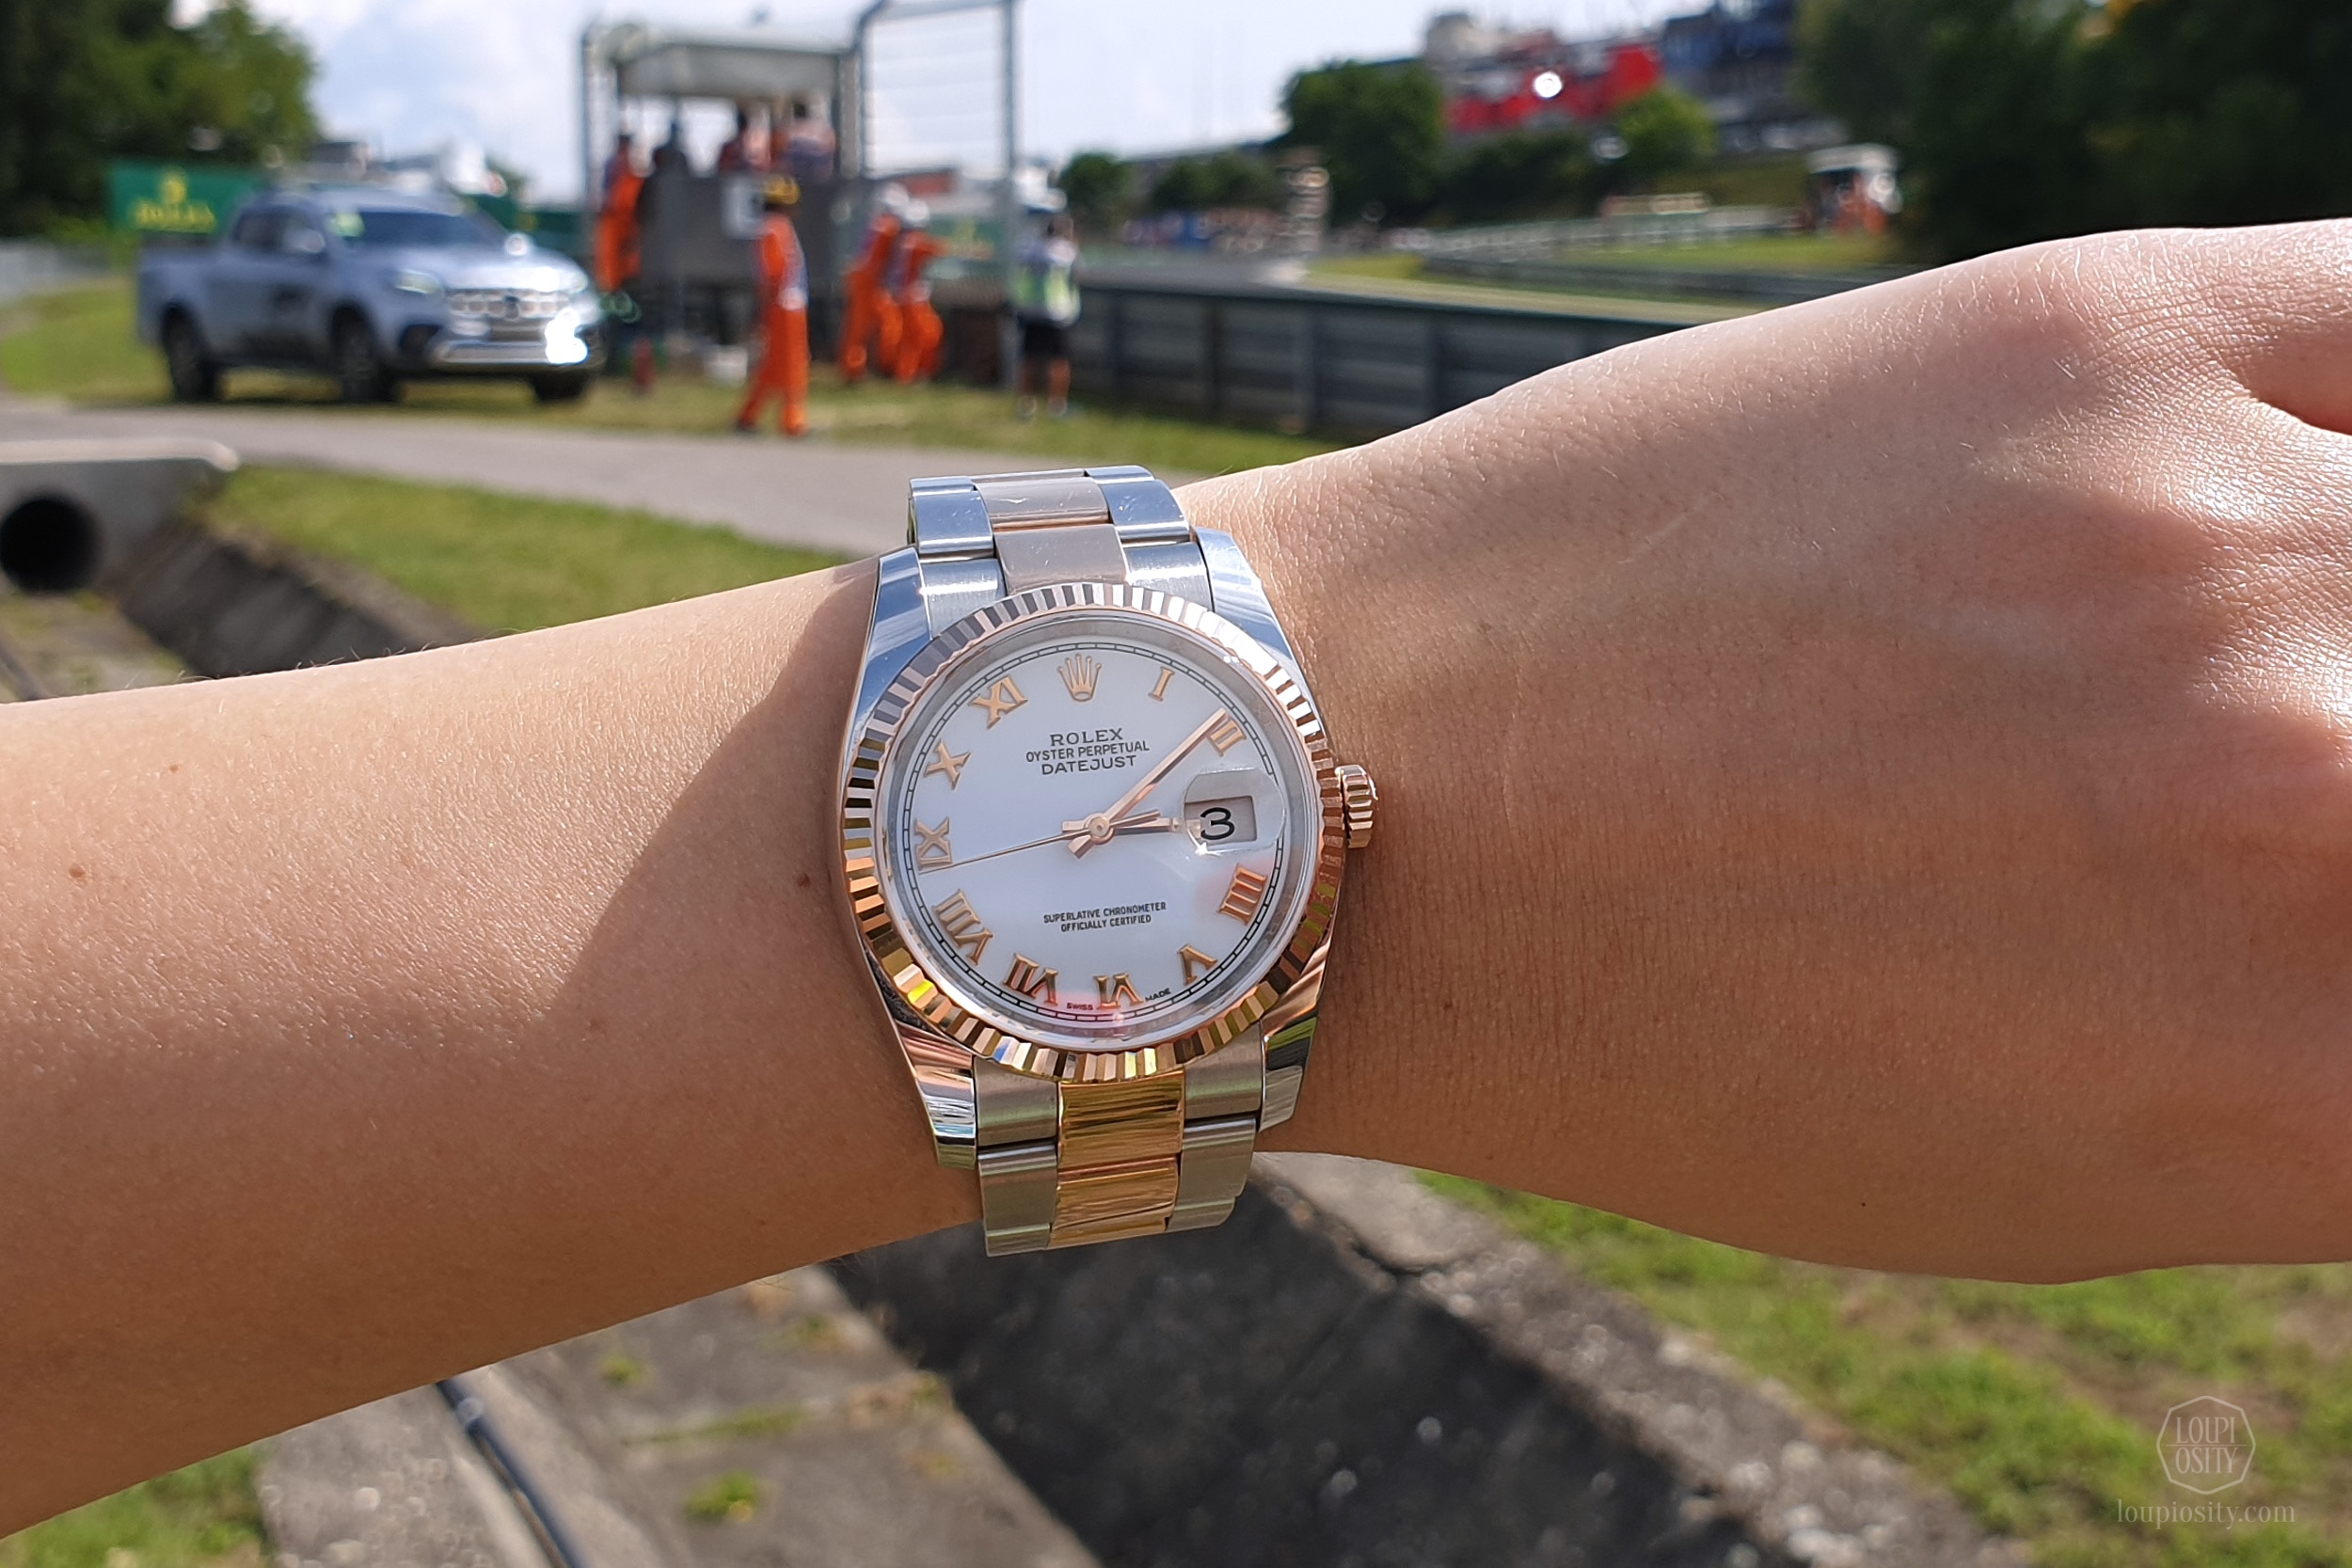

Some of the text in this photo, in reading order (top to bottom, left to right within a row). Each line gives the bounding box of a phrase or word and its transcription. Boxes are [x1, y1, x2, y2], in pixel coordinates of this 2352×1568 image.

[1148, 666, 1175, 702] I
[968, 674, 1028, 730] XI
[1025, 740, 1150, 763] OYSTER PERPETUAL
[1049, 728, 1123, 747] ROLEX
[923, 738, 971, 790] X
[1041, 754, 1136, 775] DATEJUST
[1200, 806, 1235, 841] 3
[914, 816, 953, 871] IX
[1043, 901, 1167, 924] SUPERLATIVE CHRONOMETER
[1060, 914, 1152, 932] OFFICIALLY CERTIFIED
[1177, 943, 1217, 985] V
[1066, 988, 1172, 1011] SWISS MADE
